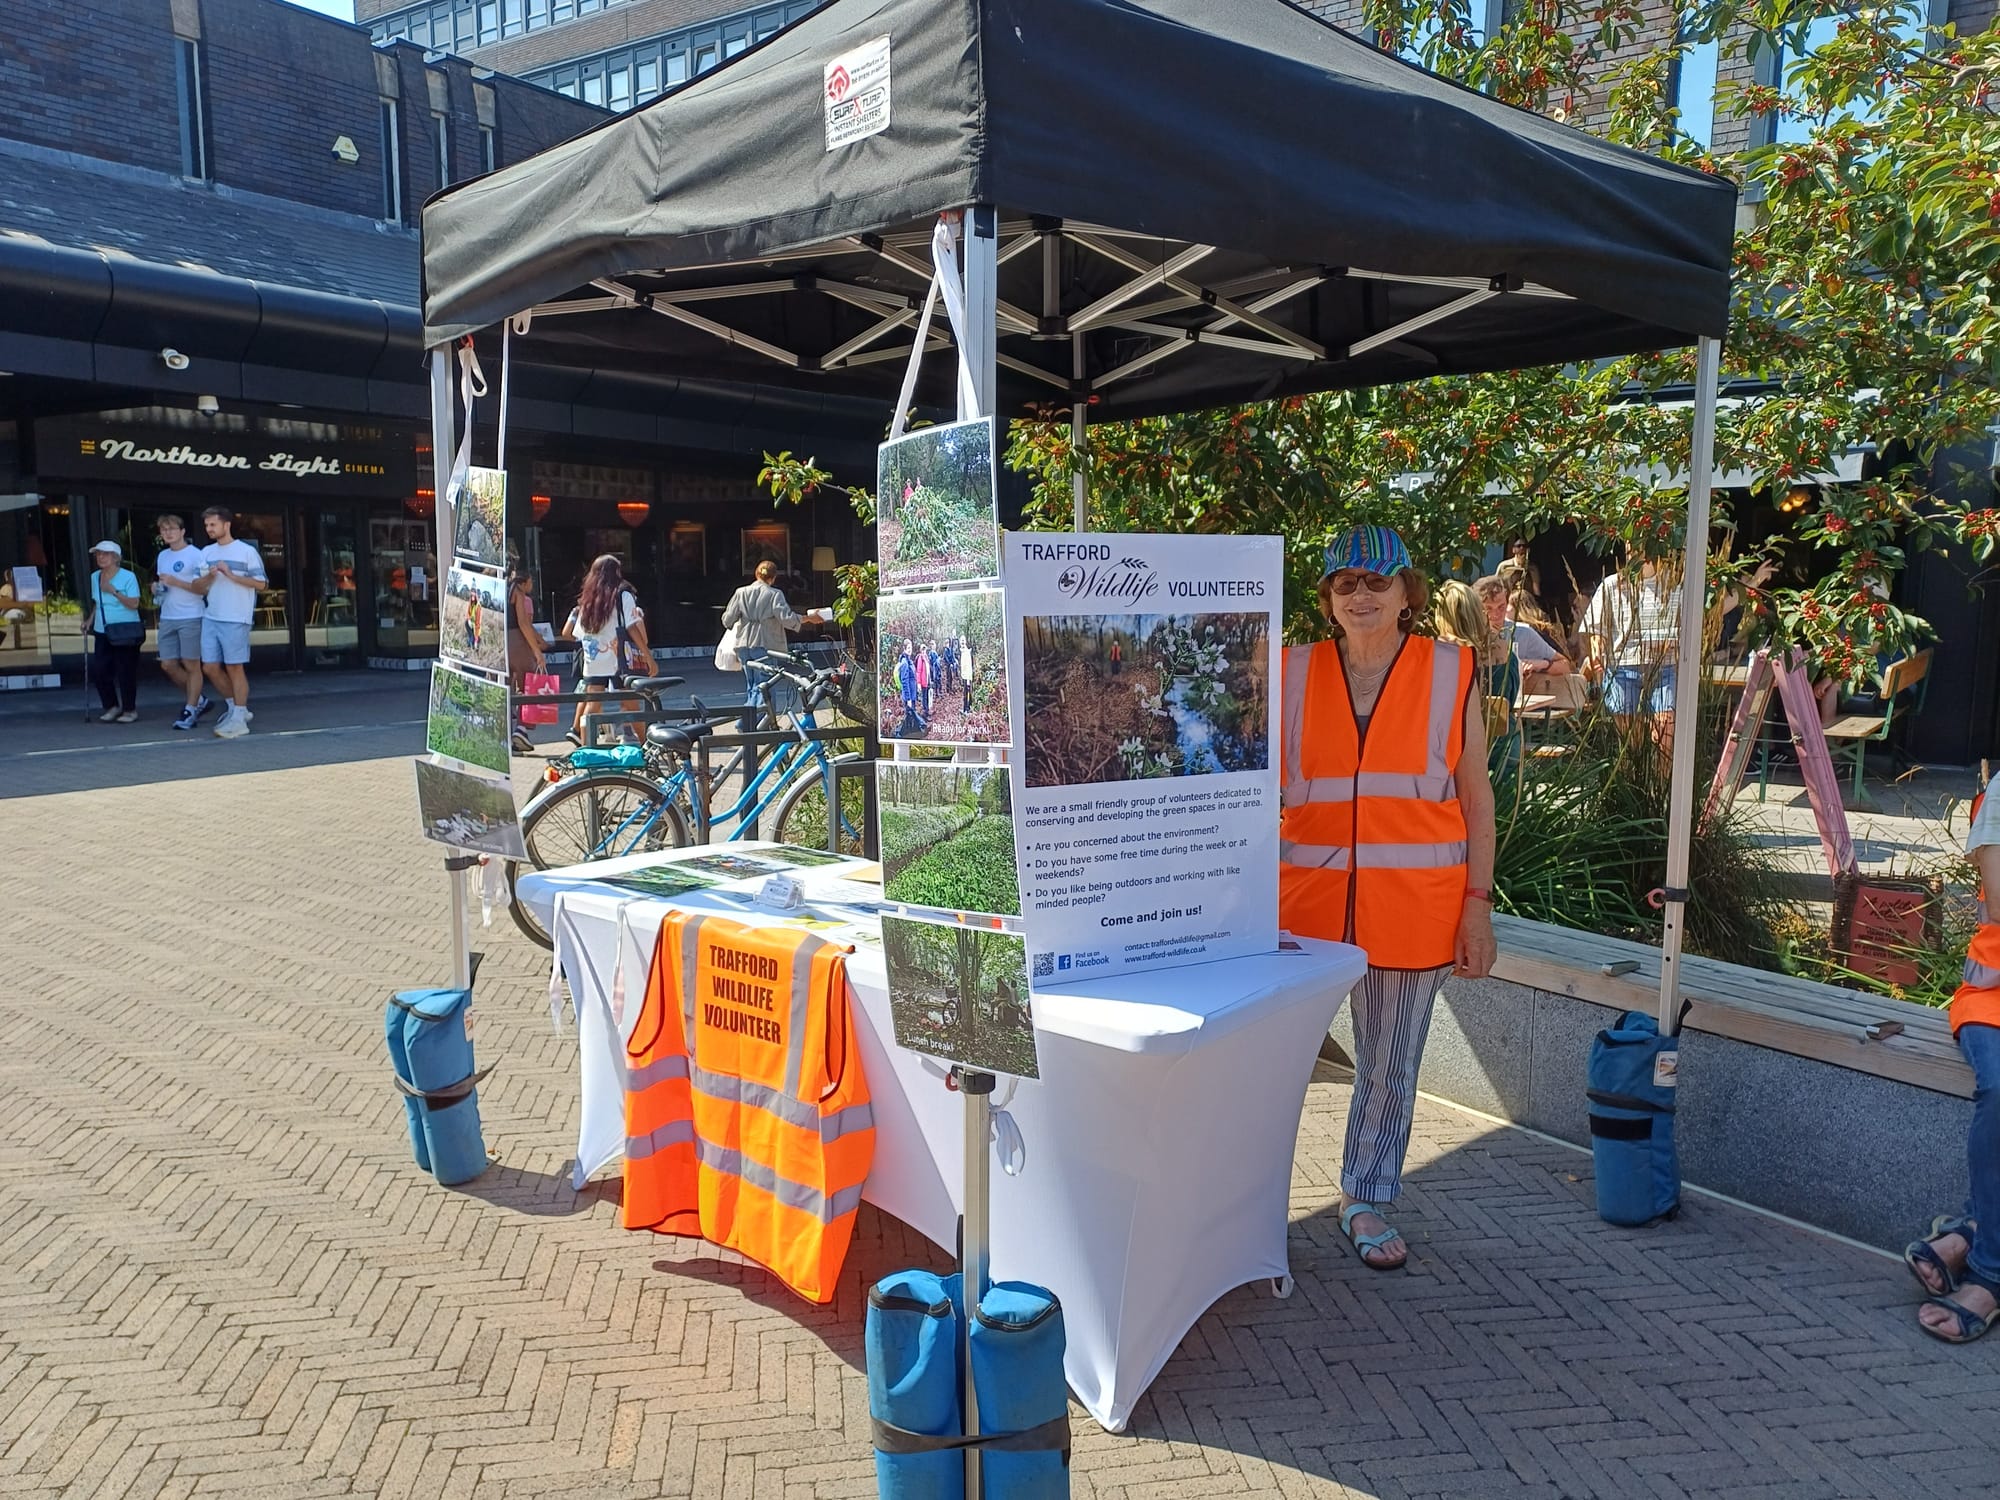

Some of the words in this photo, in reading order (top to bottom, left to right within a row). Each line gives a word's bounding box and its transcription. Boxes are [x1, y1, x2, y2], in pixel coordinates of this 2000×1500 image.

[834, 104, 854, 120] SURF
[862, 92, 881, 107] TURF
[857, 108, 881, 126] SHELTERS
[100, 439, 251, 469] Northern
[259, 452, 341, 478] Light
[345, 464, 385, 475] CINEMA
[1022, 544, 1110, 560] TRAFFORD
[1058, 563, 1159, 607] Wildlife
[1169, 581, 1264, 597] VOLUNTEERS
[933, 723, 953, 735] Ready
[956, 724, 966, 734] for
[1026, 806, 1040, 815] We
[1043, 806, 1057, 814] are
[1069, 801, 1092, 811] small
[1096, 799, 1128, 810] friendly
[1131, 798, 1155, 808] group
[1158, 795, 1167, 804] of
[1169, 791, 1211, 803] volunteers
[1214, 787, 1251, 798] dedicated
[1026, 816, 1074, 827] conserving
[1078, 814, 1094, 823] and
[1097, 810, 1143, 821] developing
[1147, 808, 1160, 817] the
[1163, 805, 1186, 817] green
[1189, 803, 1215, 813] spaces
[1218, 802, 1225, 810] in
[1228, 801, 1241, 809] our
[1243, 799, 1262, 808] area.
[1035, 842, 1050, 851] Are
[1054, 841, 1070, 851] you
[1073, 835, 1118, 847] concerned
[1121, 833, 1145, 843] about
[1148, 832, 1161, 840] the
[1164, 825, 1219, 838] environment?
[1035, 860, 1047, 868] Do
[1051, 858, 1067, 868] you
[1071, 855, 1091, 864] have
[1095, 853, 1117, 862] some
[1121, 850, 1137, 859] free
[1140, 848, 1158, 857] time
[1162, 846, 1187, 855] during
[1191, 844, 1203, 852] the
[1206, 840, 1226, 849] week
[1035, 867, 1084, 880] weekends?
[1035, 888, 1048, 898] Do
[1051, 887, 1067, 898] you
[1071, 883, 1085, 893] like
[1088, 880, 1112, 893] being
[1116, 877, 1152, 889] outdoors
[1155, 875, 1170, 884] and
[1173, 872, 1205, 883] working
[1208, 868, 1224, 877] with
[1227, 866, 1240, 875] like
[1035, 898, 1069, 910] minded
[1072, 893, 1106, 907] people?
[1101, 916, 1133, 927] Come
[1137, 911, 1158, 923] and
[1161, 908, 1182, 923] join
[1186, 905, 1202, 916] us!
[1125, 943, 1150, 951] contact:
[1151, 931, 1231, 948] traffordwildlife@gmail.com
[1125, 945, 1206, 963] www.trafford-wildlife.co.uk
[710, 945, 777, 981] TRAFFORD
[1076, 955, 1109, 968] Facebook
[712, 976, 773, 1011] WILDLIFE
[704, 1003, 781, 1044] VOLUNTEER
[907, 1033, 928, 1046] Lunch
